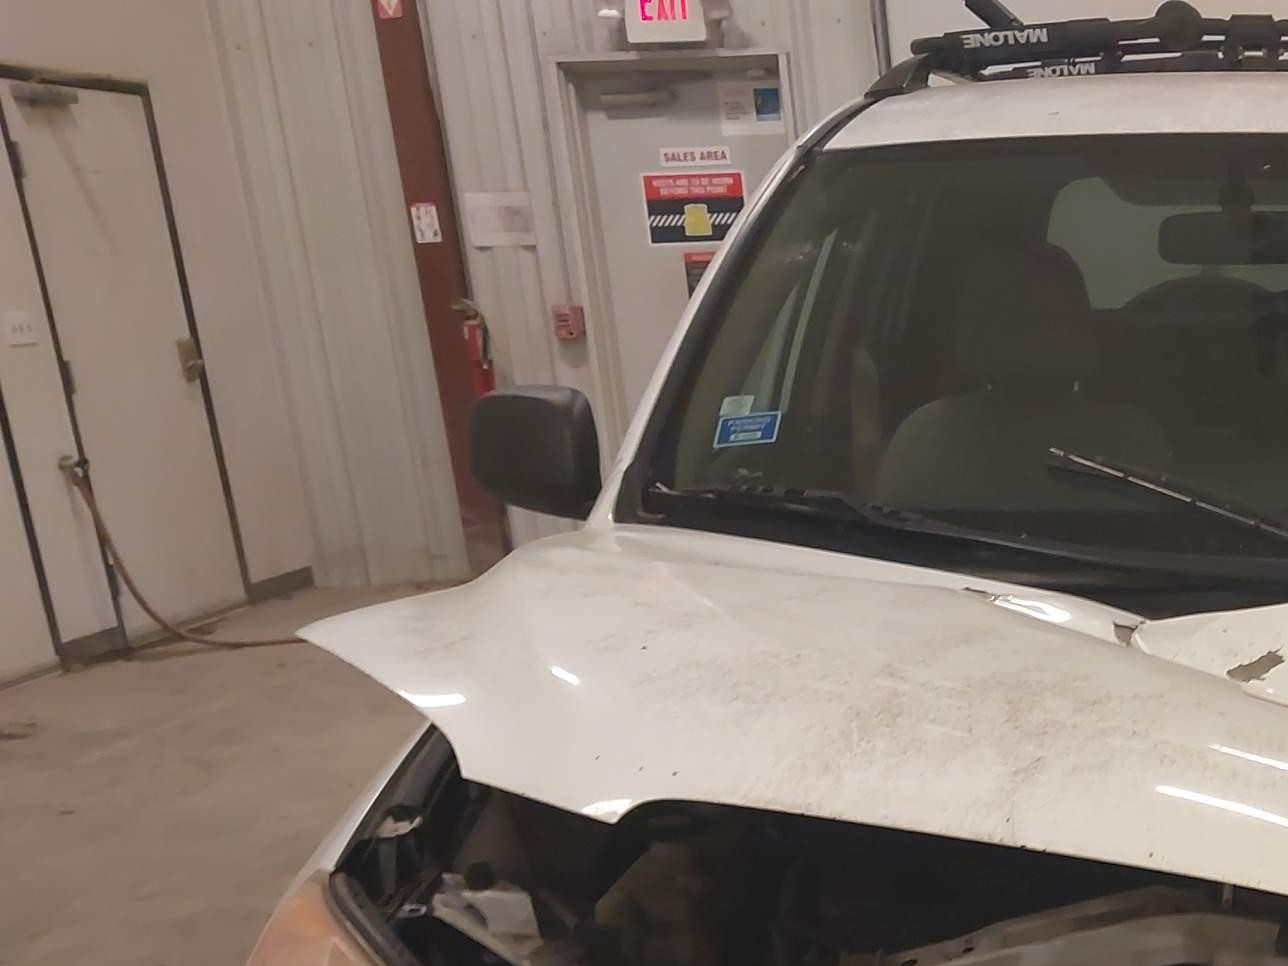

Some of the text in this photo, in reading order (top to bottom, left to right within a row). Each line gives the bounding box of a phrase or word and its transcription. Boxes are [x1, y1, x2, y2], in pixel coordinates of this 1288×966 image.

[960, 28, 1048, 49] MALONE
[1026, 63, 1096, 79] MALONE
[664, 150, 727, 162] SALES AREA
